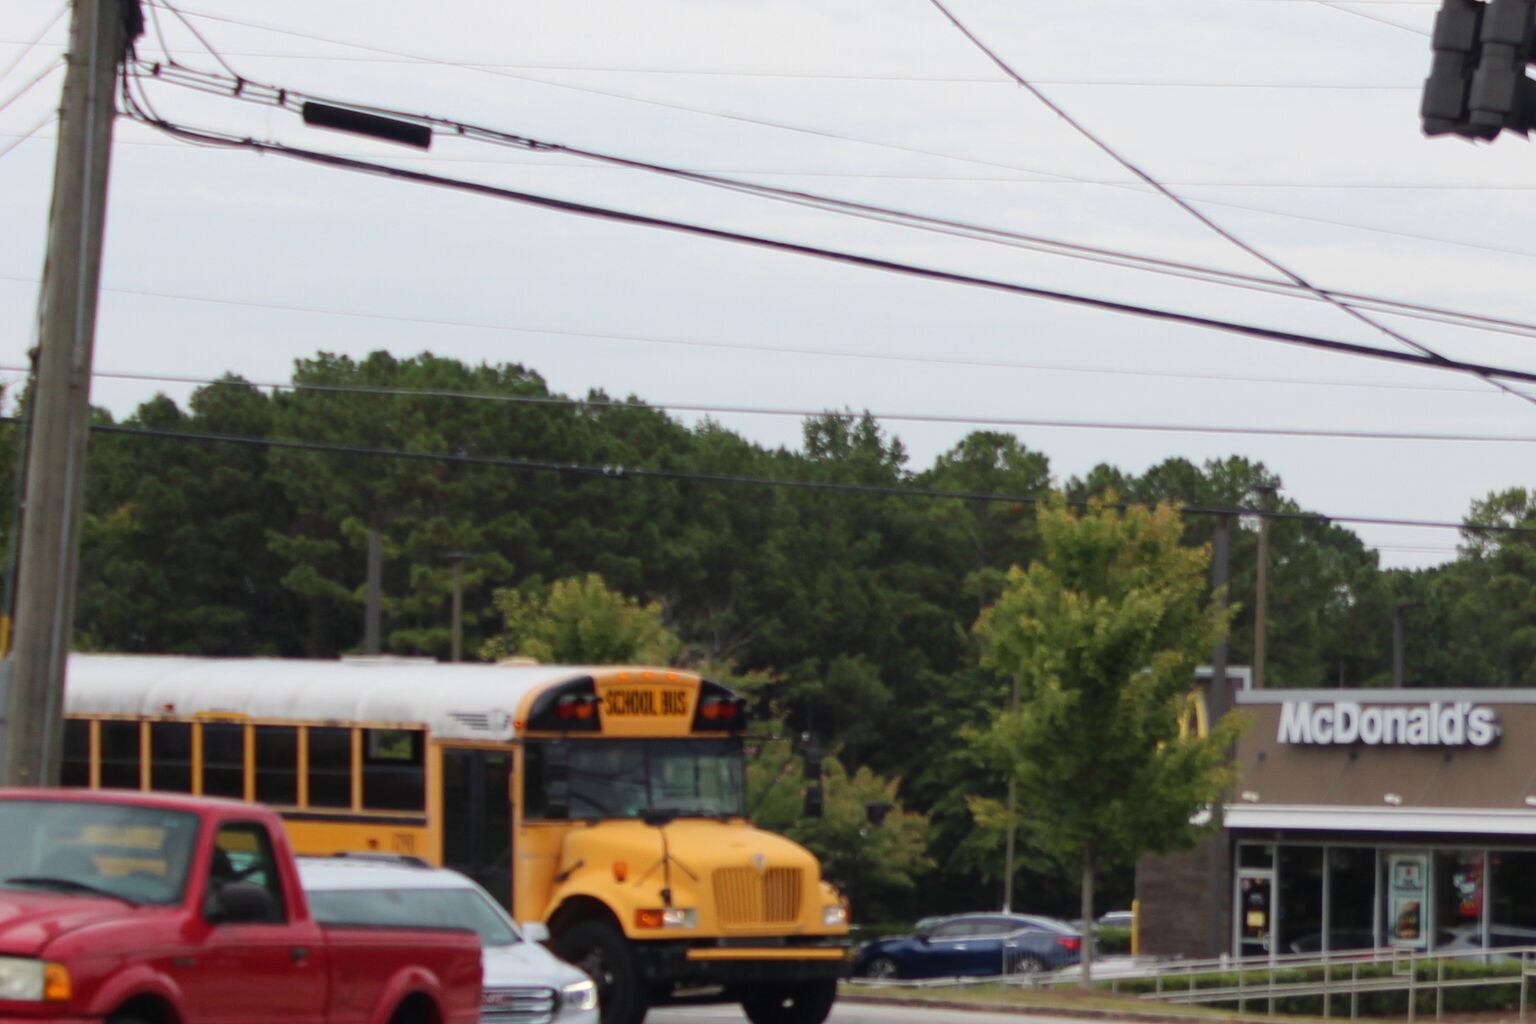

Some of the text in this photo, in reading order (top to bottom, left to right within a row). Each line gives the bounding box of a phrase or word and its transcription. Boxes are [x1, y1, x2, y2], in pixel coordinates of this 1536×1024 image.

[606, 689, 687, 716] SCHOOL BUS
[1276, 699, 1496, 746] McDonald's
